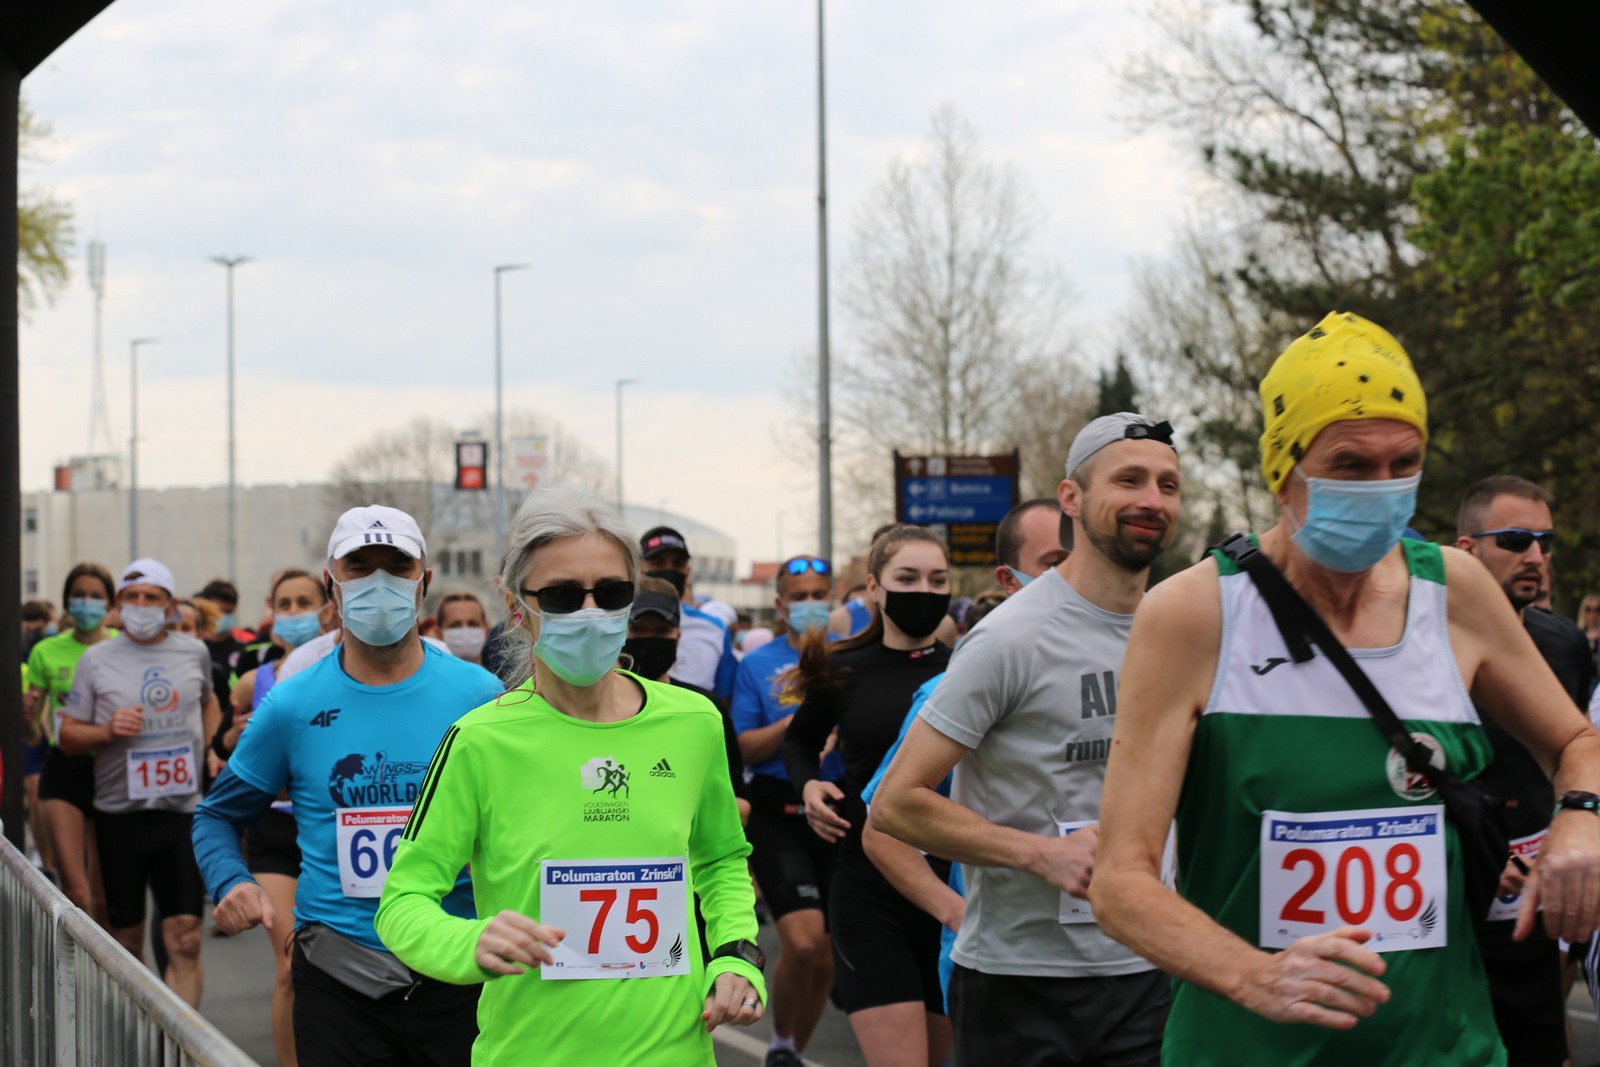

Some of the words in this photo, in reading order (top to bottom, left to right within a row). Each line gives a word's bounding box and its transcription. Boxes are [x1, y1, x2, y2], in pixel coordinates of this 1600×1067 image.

[1081, 670, 1119, 719] AI
[310, 709, 341, 727] 4F
[136, 757, 188, 788] 158
[649, 769, 676, 778] adidas
[348, 782, 418, 807] WORLD
[345, 813, 409, 825] Polumaraton
[583, 814, 630, 823] MARATON
[1274, 821, 1374, 840] Polumaraton
[552, 869, 636, 883] Polumaraton
[1278, 842, 1424, 926] 208
[579, 888, 660, 954] 75
